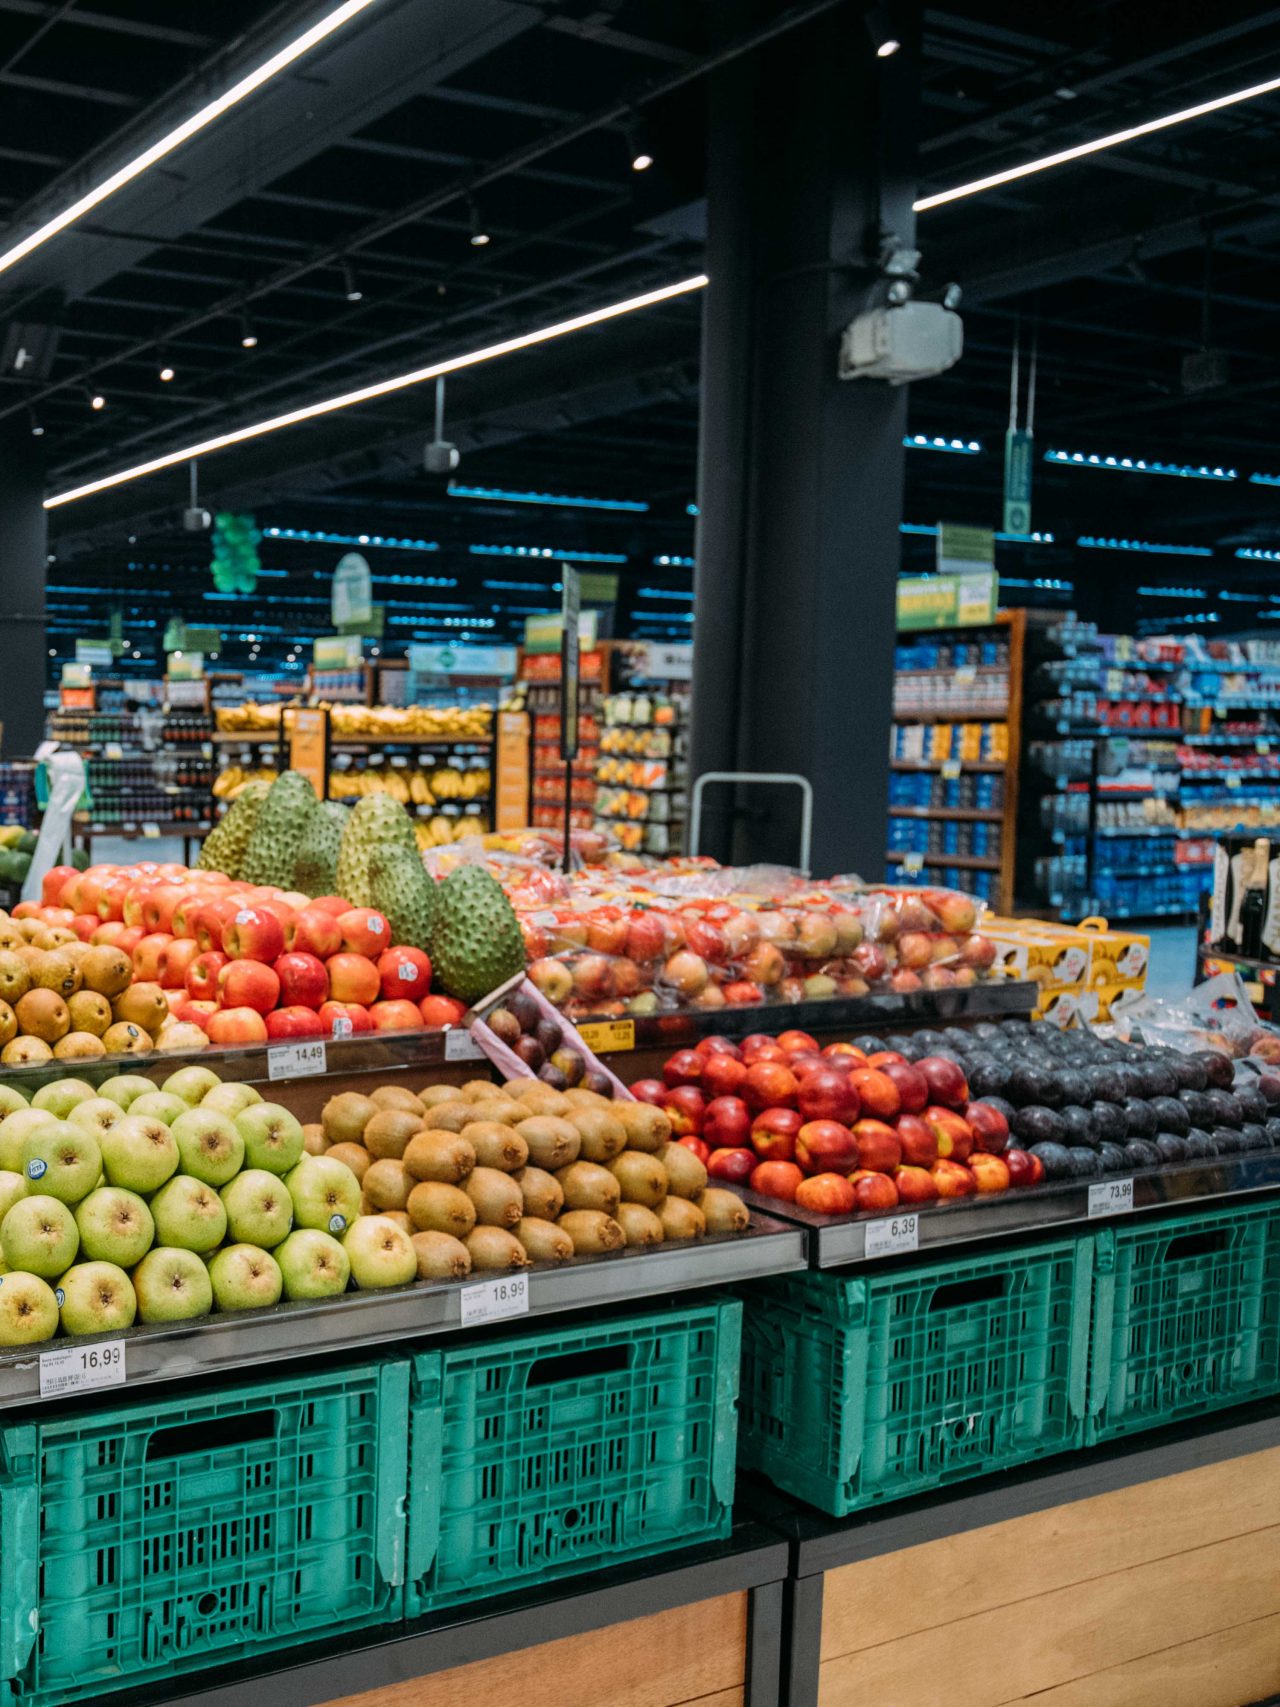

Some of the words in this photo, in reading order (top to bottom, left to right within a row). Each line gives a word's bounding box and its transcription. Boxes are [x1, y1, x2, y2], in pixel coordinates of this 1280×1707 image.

[296, 1046, 323, 1061] 14,49
[1110, 1183, 1132, 1199] 73,99
[891, 1217, 915, 1238] 6,39
[494, 1281, 525, 1301] 18,99
[80, 1347, 120, 1369] 16,99
